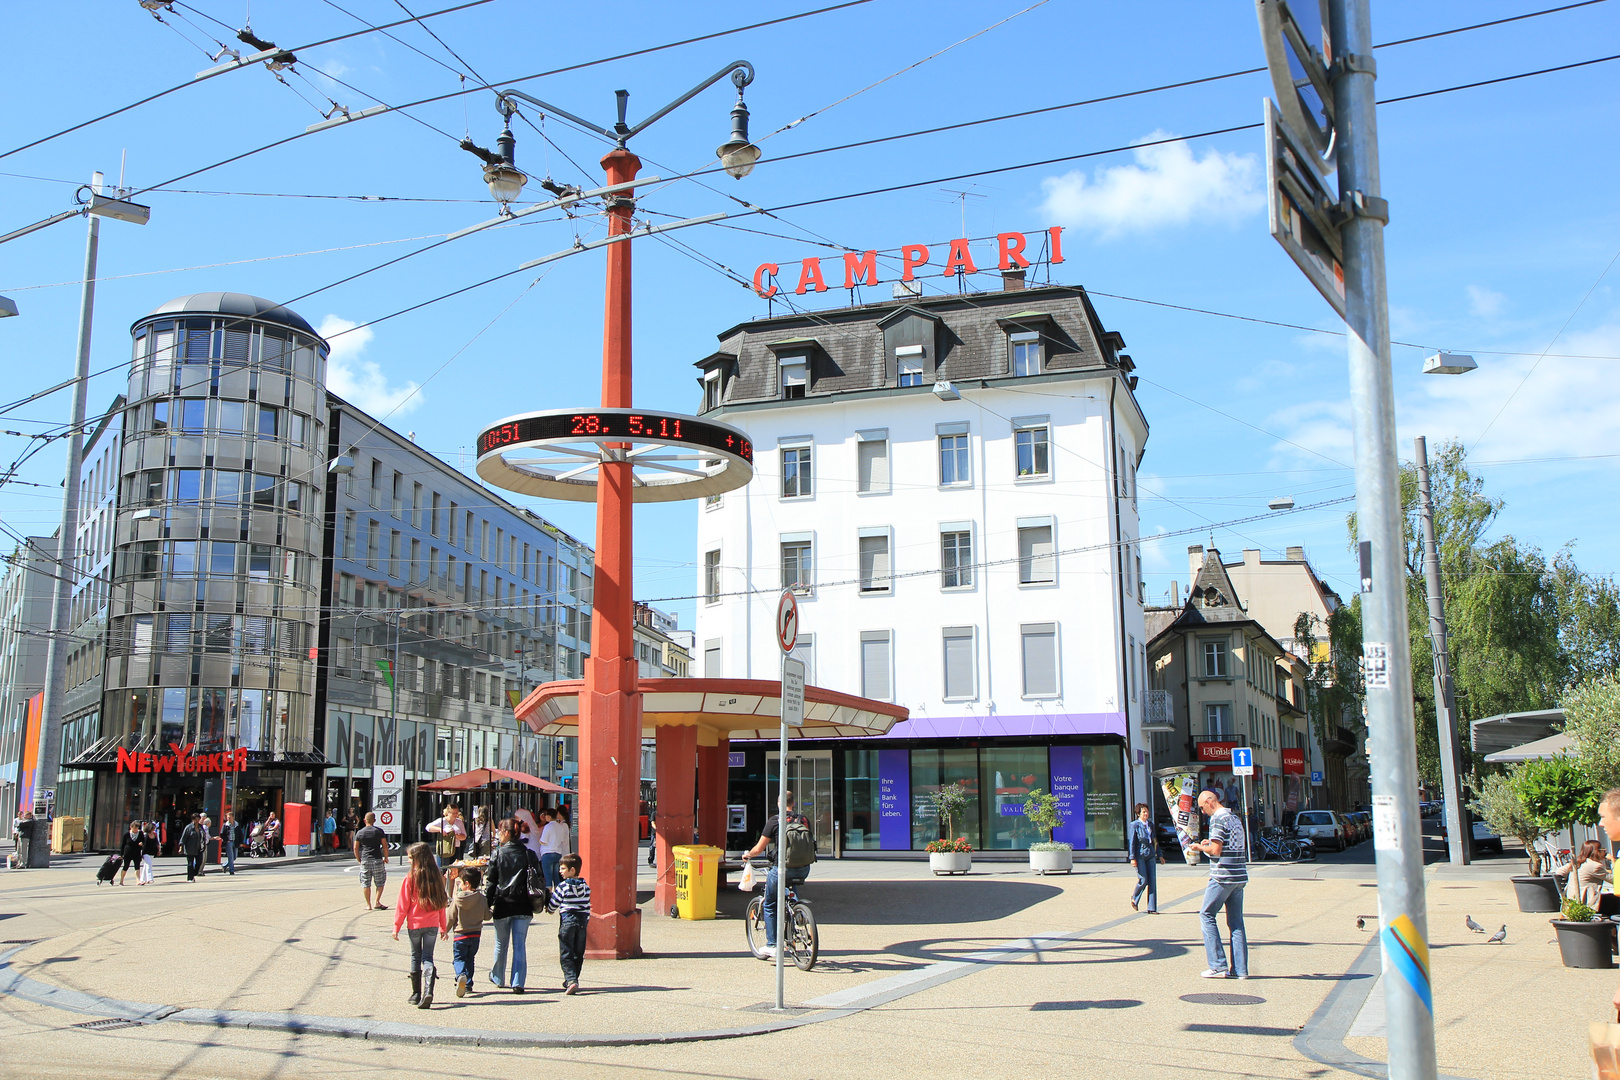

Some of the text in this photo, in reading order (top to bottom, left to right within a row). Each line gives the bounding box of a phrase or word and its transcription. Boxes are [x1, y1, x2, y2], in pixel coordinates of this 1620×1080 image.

[753, 226, 1065, 299] CAMPARI
[483, 423, 520, 451] 10:51
[571, 415, 610, 434] 28.
[629, 416, 682, 438] 5.11
[676, 870, 688, 889] für
